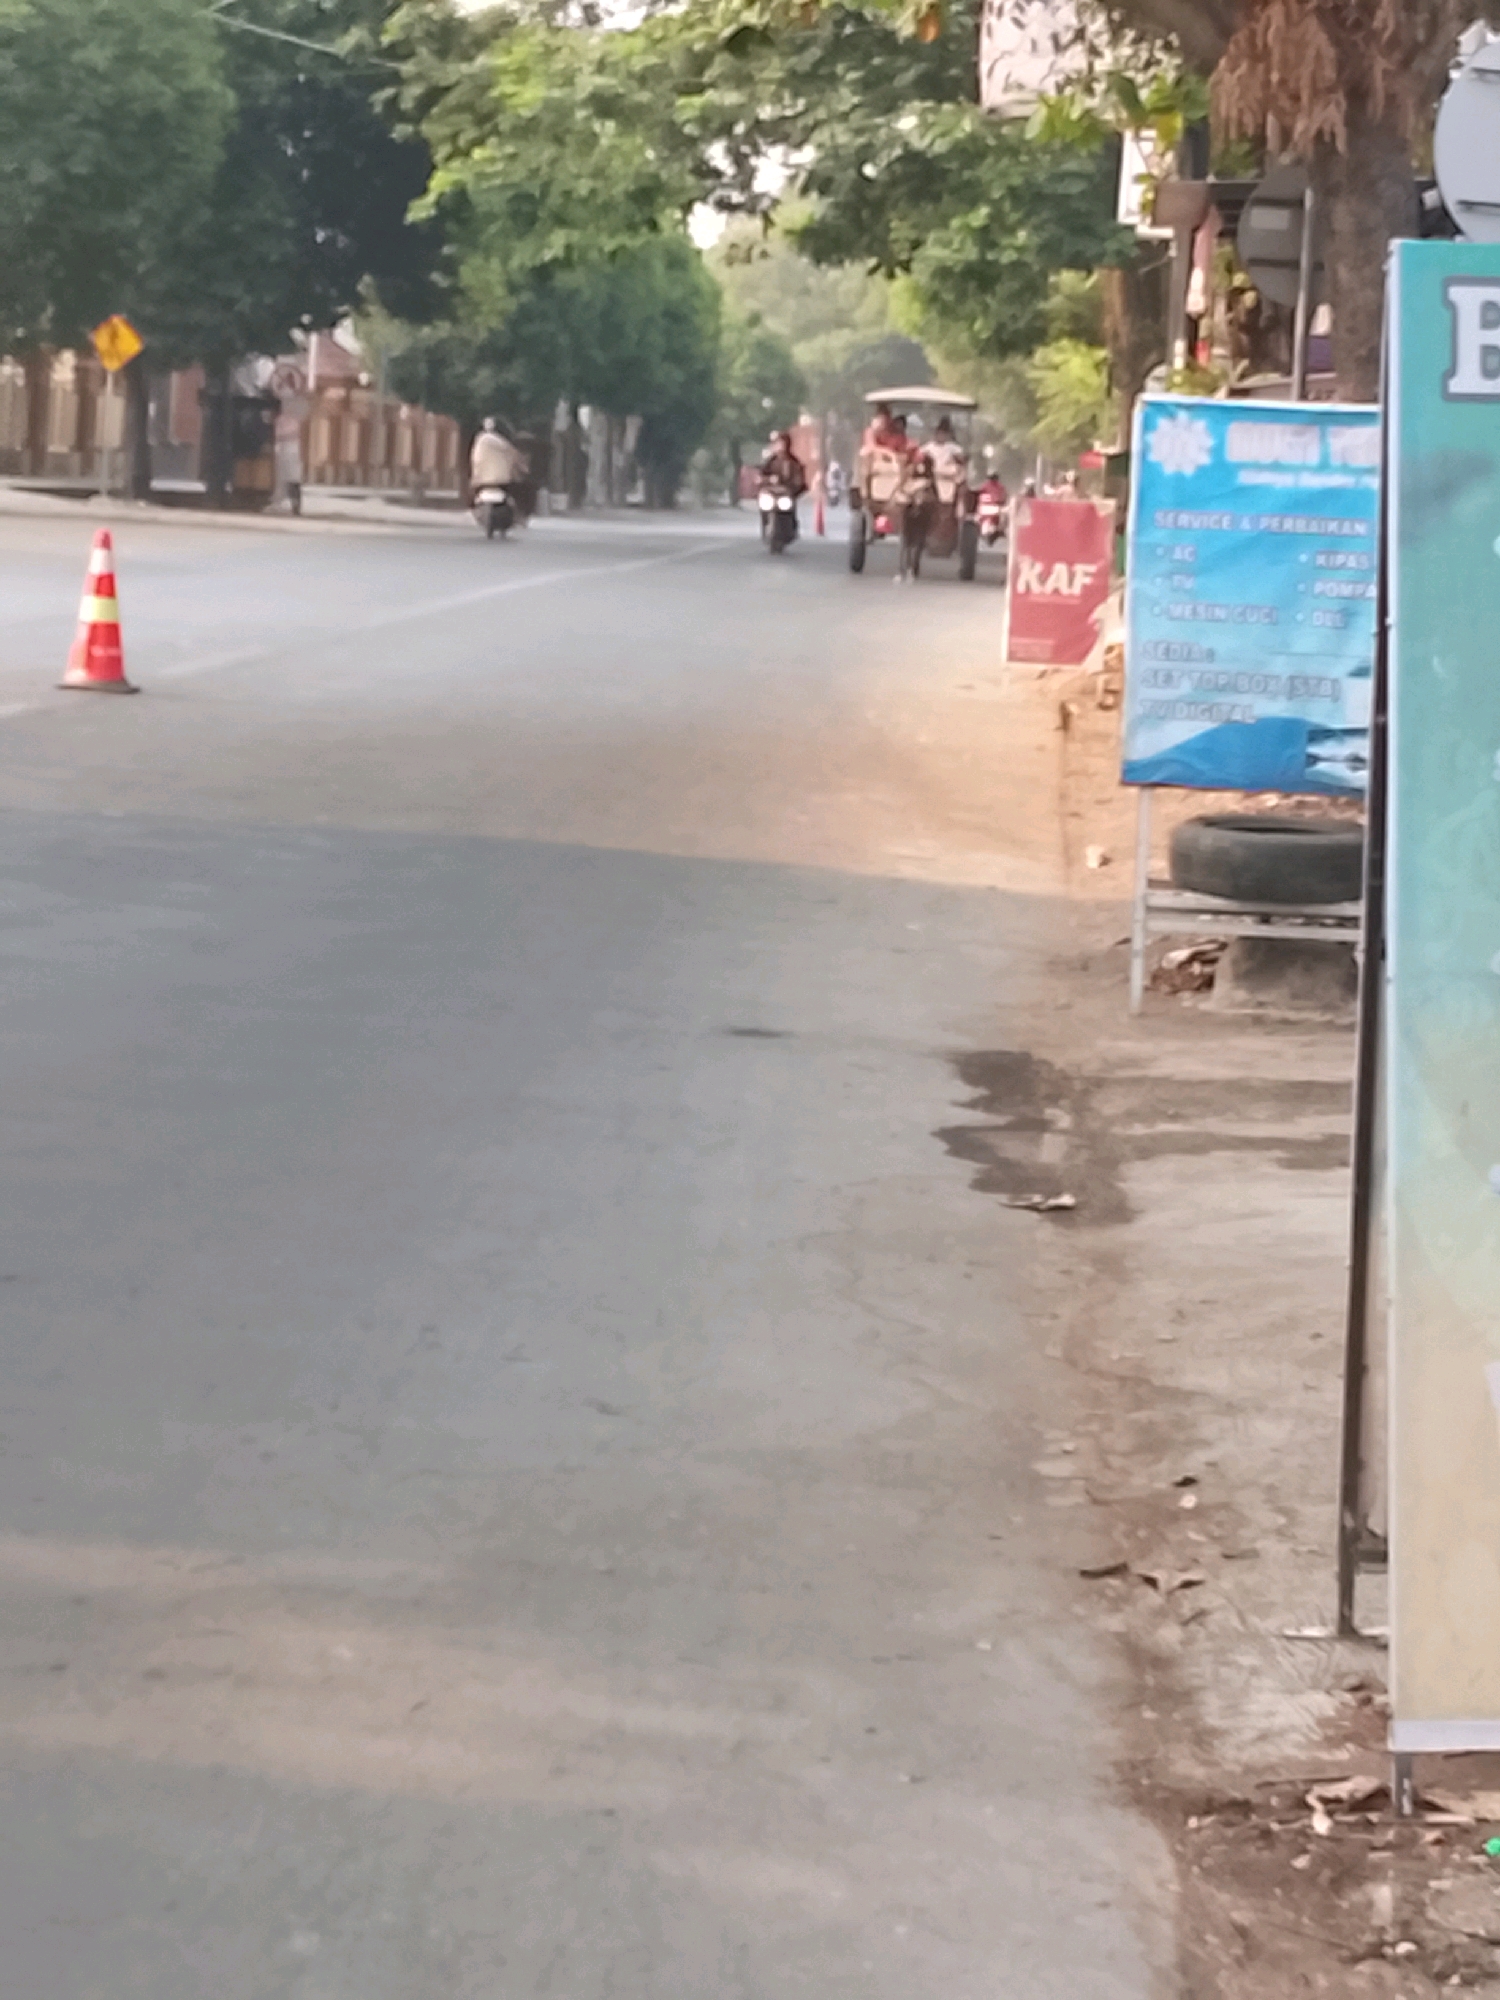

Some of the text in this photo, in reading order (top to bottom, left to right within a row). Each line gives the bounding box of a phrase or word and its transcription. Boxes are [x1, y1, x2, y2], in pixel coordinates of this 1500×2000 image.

[1155, 511, 1232, 530] SERVICE
[1258, 515, 1368, 536] PERBAIKAN
[1172, 545, 1195, 562] AC
[1316, 553, 1369, 569] KIPAS
[1016, 559, 1098, 596] KAF
[1169, 604, 1277, 623] MESIN CUCI
[1189, 672, 1230, 691] TOP
[1234, 673, 1281, 694] BOX
